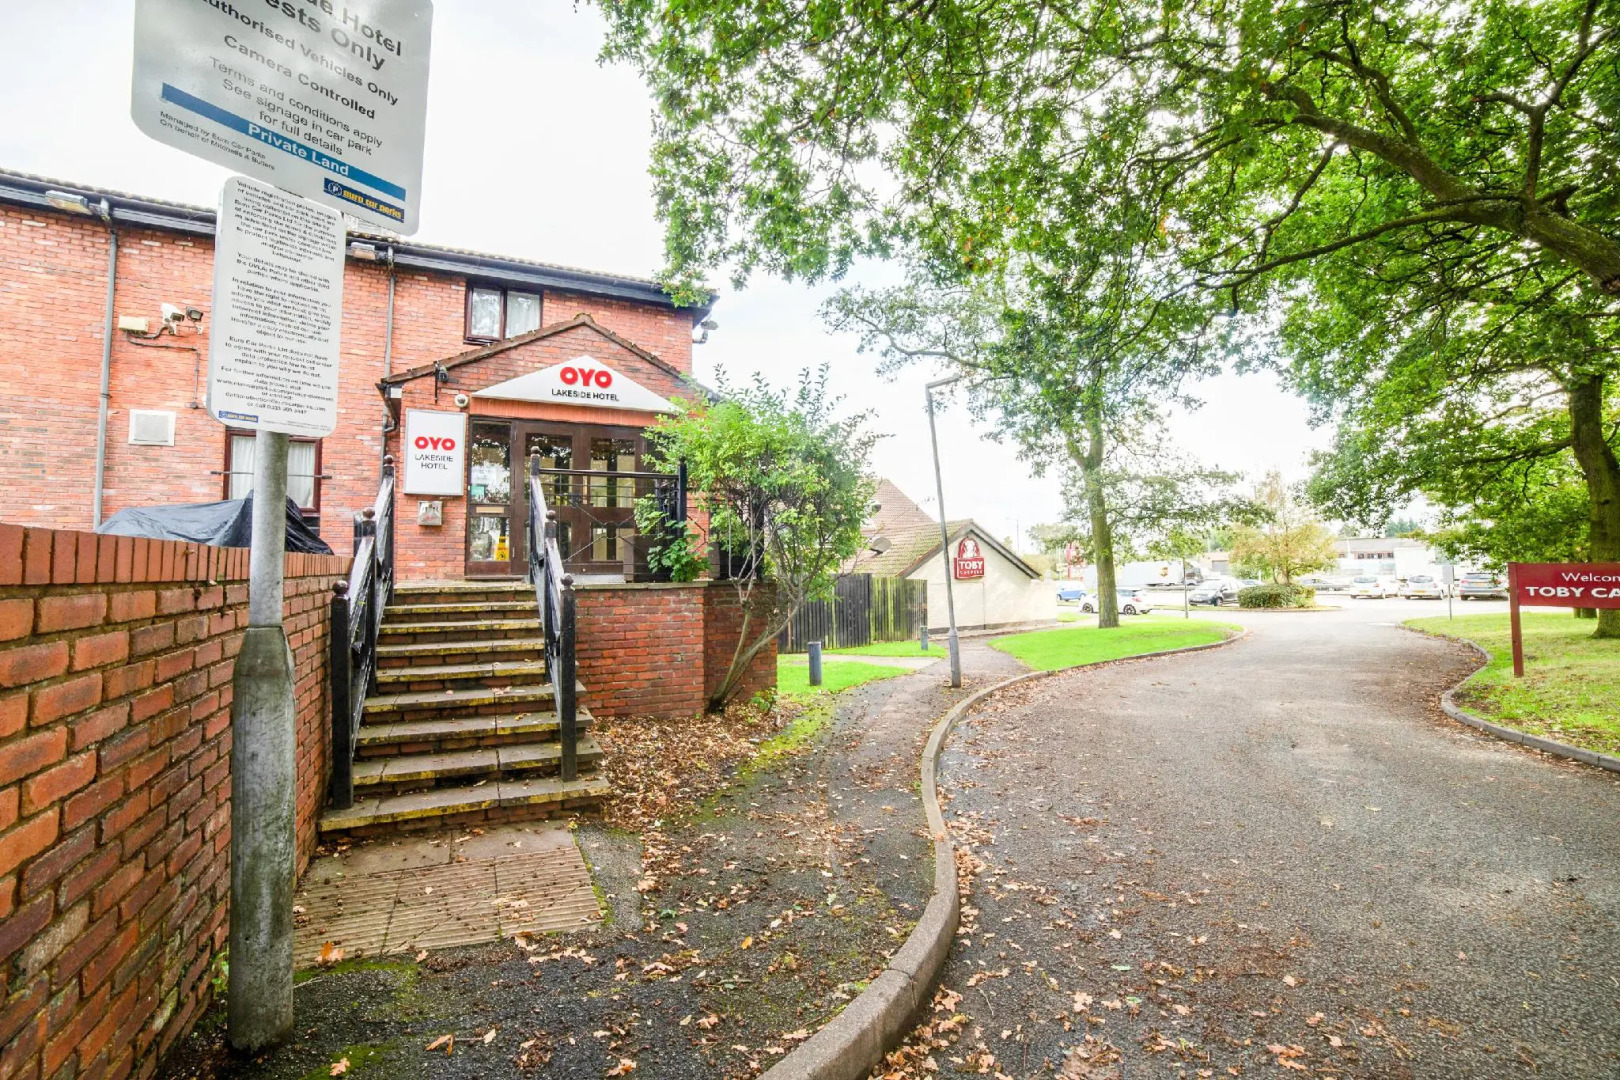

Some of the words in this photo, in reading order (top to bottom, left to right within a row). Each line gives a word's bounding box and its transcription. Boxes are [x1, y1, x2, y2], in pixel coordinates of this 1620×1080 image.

[343, 8, 401, 56] Hotel
[203, 0, 295, 50] uthorised
[300, 43, 363, 86] Vehicles
[367, 82, 398, 106] Only
[331, 28, 385, 70] Only
[224, 35, 292, 78] Camera
[298, 73, 375, 119] Controlled
[209, 55, 255, 87] Terms
[259, 84, 285, 101] and
[289, 97, 350, 132] conditions
[353, 129, 383, 148] apply
[160, 110, 199, 132] Managed
[160, 118, 173, 129] On
[222, 78, 252, 100] See
[256, 96, 308, 126] signage
[311, 120, 323, 132] in
[326, 129, 345, 142] car
[347, 139, 372, 156] park
[259, 110, 278, 126] for
[281, 120, 300, 136] full
[303, 132, 343, 155] details
[248, 122, 307, 158] Private
[311, 150, 349, 176] Land
[560, 366, 613, 389] OYO
[551, 388, 591, 399] LAKESIDE
[592, 392, 620, 402] HOTEL
[414, 436, 456, 451] OYO
[414, 453, 454, 462] LAKESIDE
[420, 462, 448, 470] HOTEL
[958, 561, 983, 570] TOBY
[1525, 586, 1585, 598] TOBY
